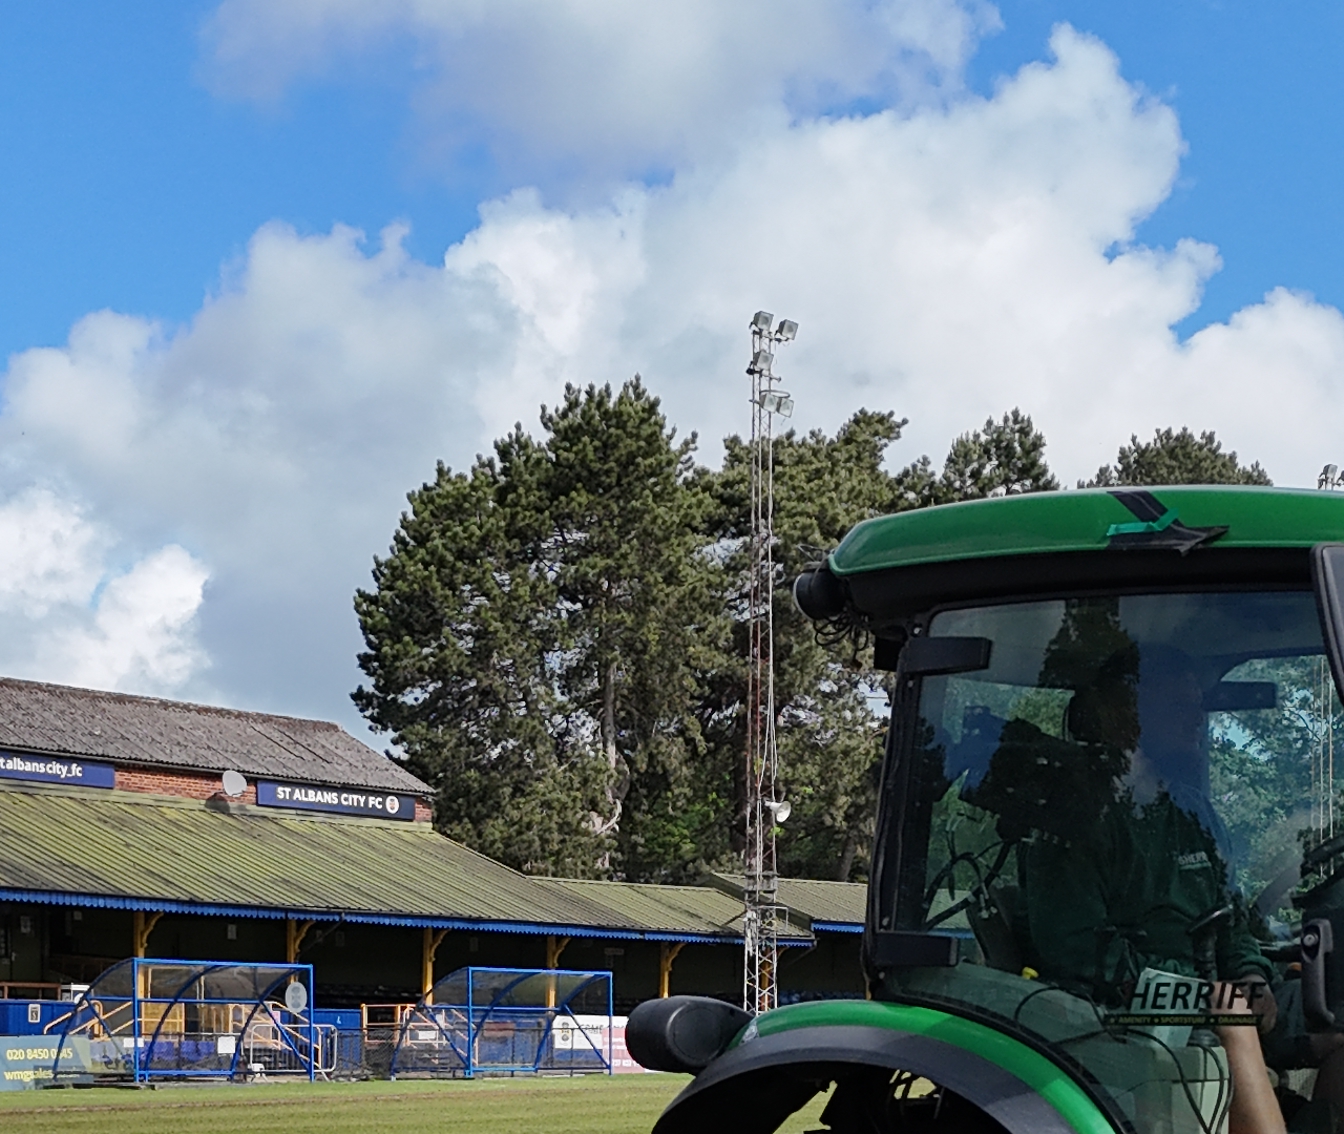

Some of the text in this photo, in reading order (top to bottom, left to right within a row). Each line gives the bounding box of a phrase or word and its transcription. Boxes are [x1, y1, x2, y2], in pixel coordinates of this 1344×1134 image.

[276, 786, 383, 809] ST ALBANS CITY FC
[1127, 982, 1267, 1010] HERRIFF
[1118, 1016, 1152, 1024] AMENITY
[6, 1048, 25, 1060] 020
[26, 1048, 49, 1060] 8450
